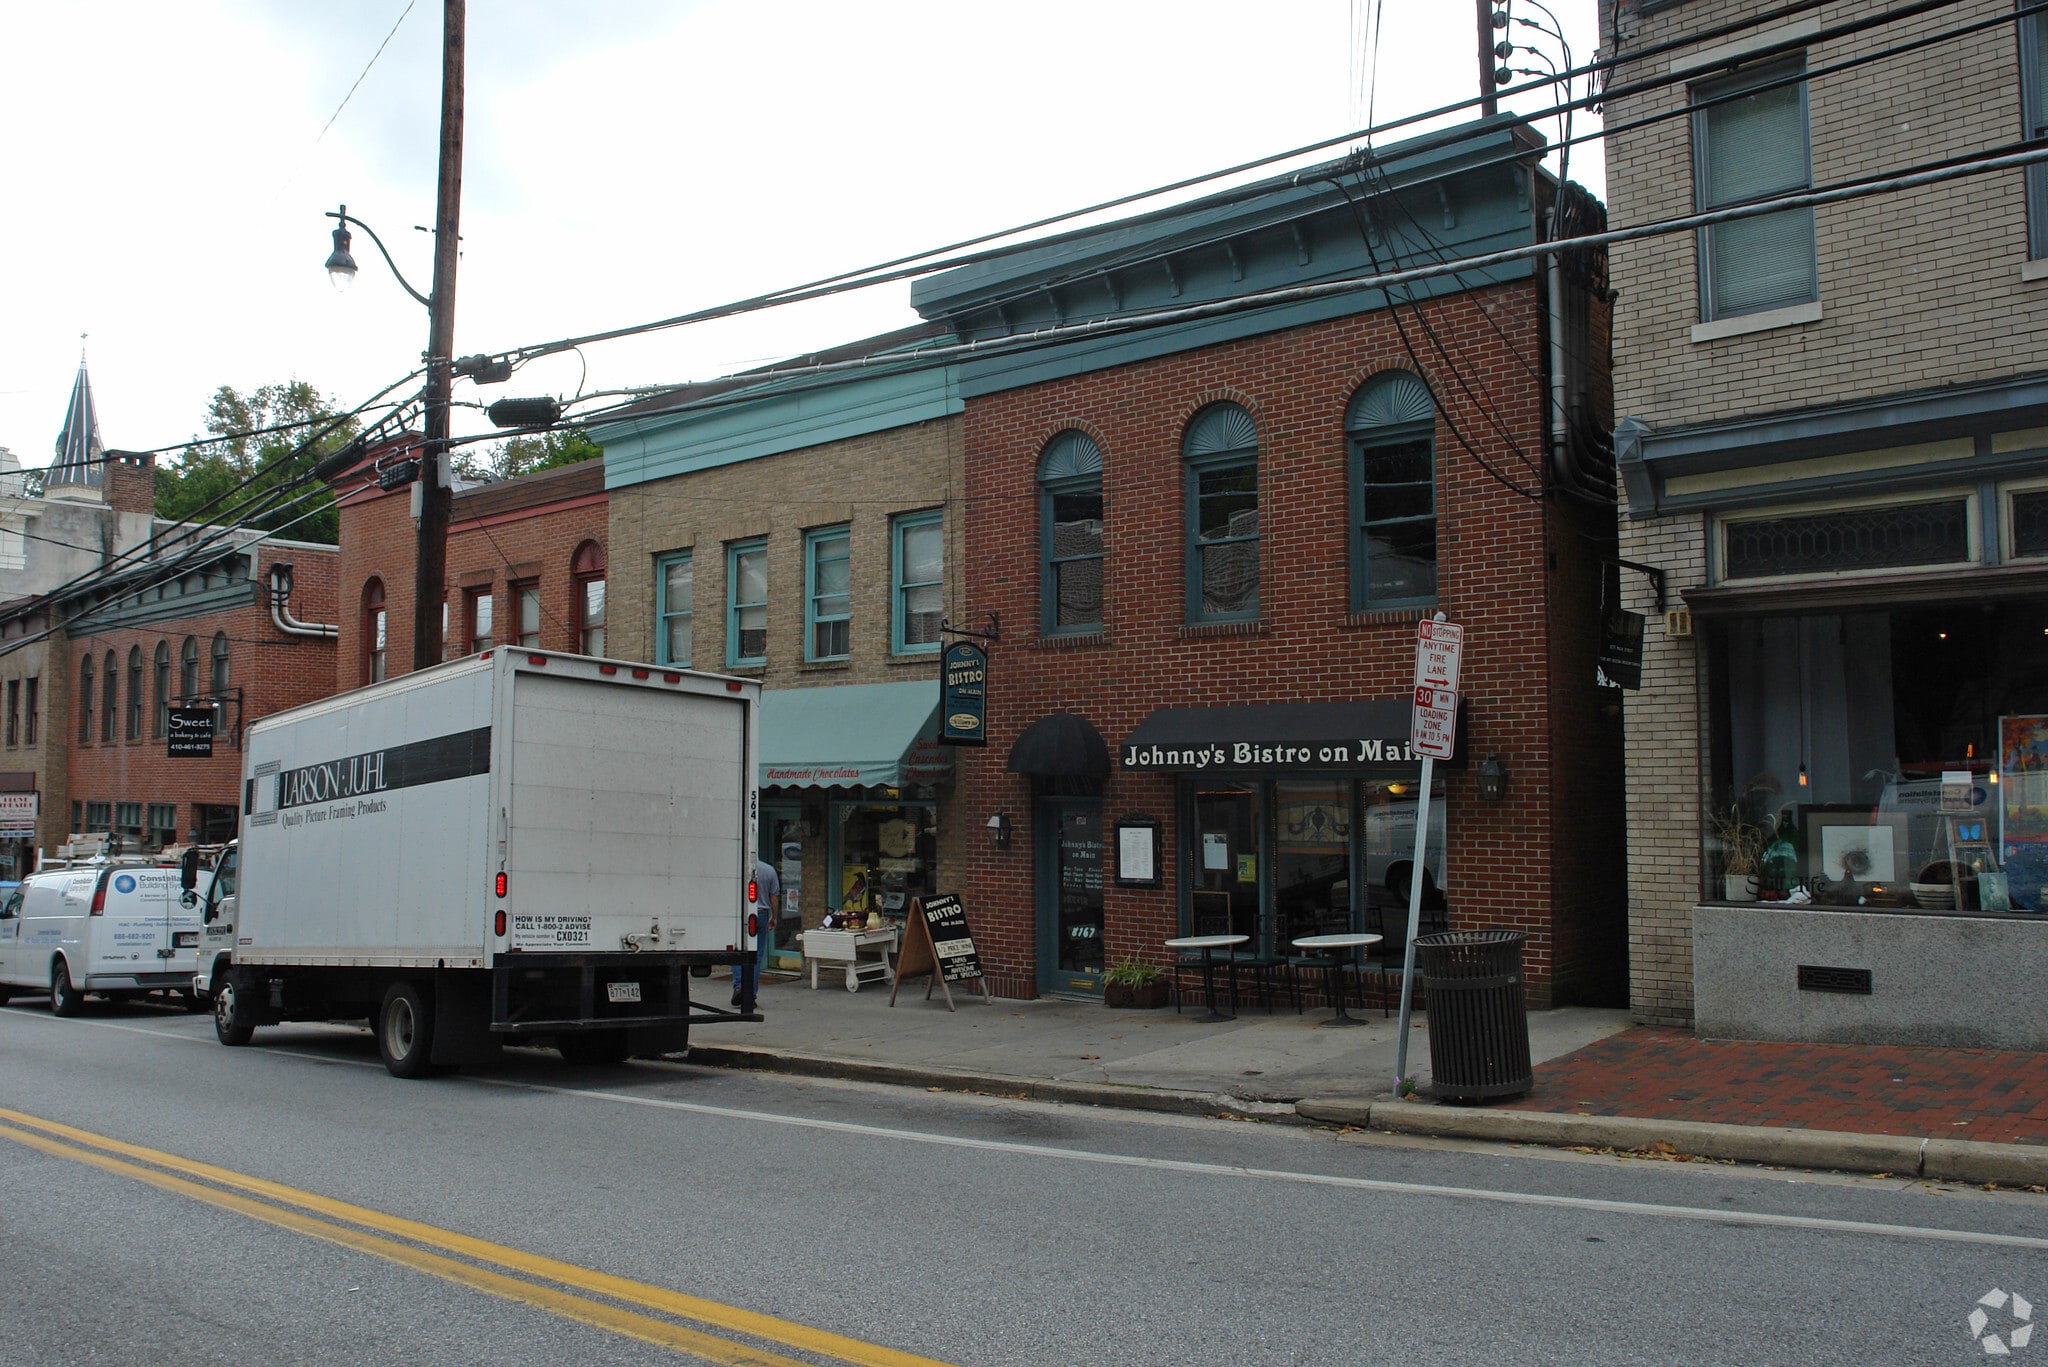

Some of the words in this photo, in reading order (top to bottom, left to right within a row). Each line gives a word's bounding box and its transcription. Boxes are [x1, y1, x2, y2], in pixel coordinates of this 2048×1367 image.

[1421, 623, 1431, 638] NO
[1432, 627, 1459, 640] STOPPING
[1423, 641, 1456, 654] ANYTIME
[949, 658, 980, 670] JOHNNY'S
[1429, 653, 1446, 664] FIRE
[1427, 664, 1447, 676] LANE
[948, 669, 984, 686] BISTRO
[958, 687, 966, 695] ON
[967, 688, 982, 696] MAIN
[1417, 689, 1431, 704] 30
[1439, 694, 1449, 703] MIN
[1420, 708, 1448, 721] LOADING
[1424, 720, 1442, 731] ZONE
[174, 731, 194, 741] bakery
[1415, 728, 1419, 738] 8
[1420, 730, 1427, 739] AM
[1429, 731, 1435, 741] TO
[1436, 732, 1441, 742] 5
[1442, 733, 1450, 743] PM
[1124, 743, 1225, 768] Johnny's
[1232, 742, 1311, 764] Bistro
[1318, 747, 1348, 763] on
[1356, 739, 1421, 763] Mai
[283, 761, 341, 807] LARSON
[344, 752, 387, 796] JUHL
[767, 768, 811, 779] Handmade
[813, 766, 859, 782] Chocolates
[282, 812, 303, 830] Quality
[305, 808, 327, 824] Picture
[329, 803, 356, 819] Framing
[358, 798, 387, 816] Products
[1087, 840, 1102, 849] Bistr
[1079, 850, 1096, 859] Main
[139, 874, 182, 883] Constella
[925, 896, 955, 909] JOHNNY'S
[926, 903, 962, 922] BISTRO
[515, 915, 533, 923] HOW
[960, 969, 982, 979] SPECIALS
